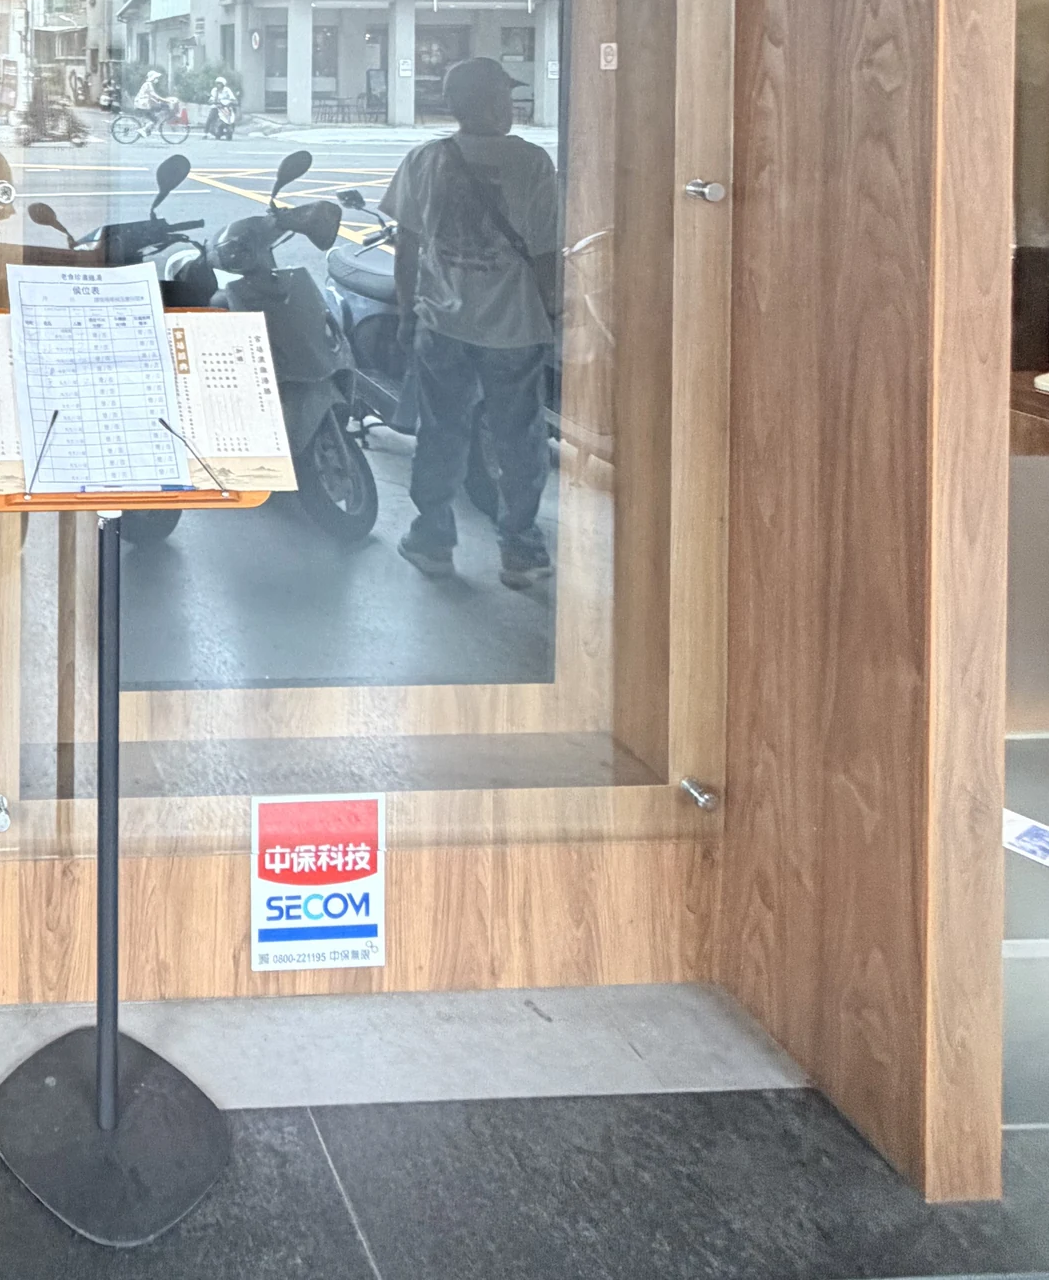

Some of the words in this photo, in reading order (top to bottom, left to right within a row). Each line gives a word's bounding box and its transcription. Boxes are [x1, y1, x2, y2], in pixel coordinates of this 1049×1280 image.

[264, 842, 371, 874] 中保科技
[266, 892, 370, 921] SECOM
